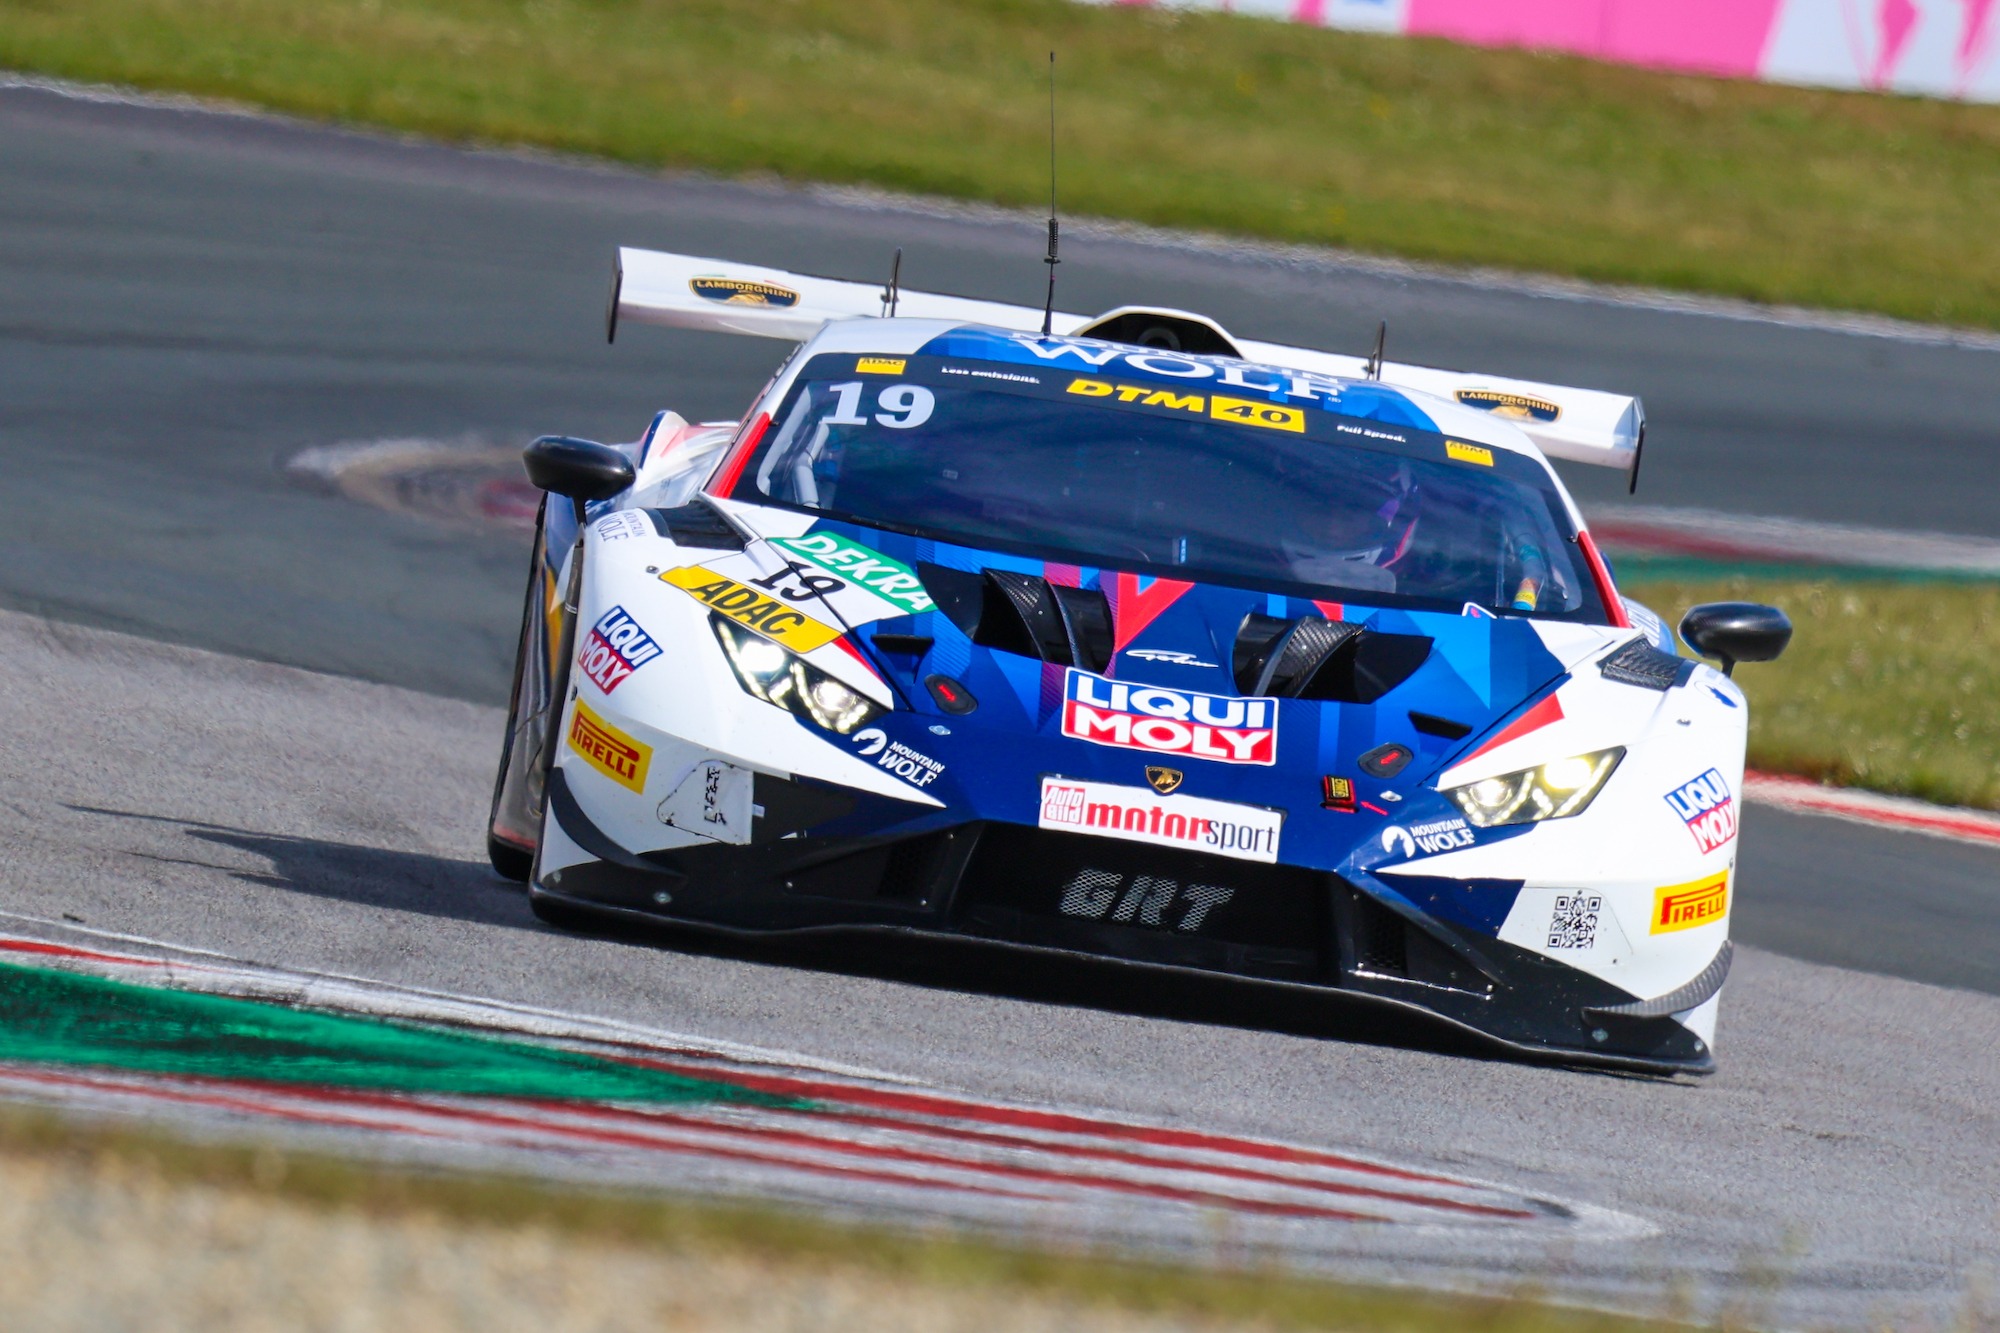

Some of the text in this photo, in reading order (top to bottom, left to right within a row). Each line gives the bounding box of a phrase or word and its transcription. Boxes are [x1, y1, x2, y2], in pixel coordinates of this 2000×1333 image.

[696, 281, 793, 299] LAMBORGHINI
[1010, 338, 1347, 400] WOLF
[821, 381, 935, 429] 19
[1066, 379, 1292, 424] DTM 40
[1461, 391, 1555, 413] LAMBORGHINI
[747, 560, 846, 601] 19
[783, 535, 933, 610] DEKRA
[686, 580, 806, 636] ADAC
[579, 633, 632, 689] MOLY
[596, 607, 660, 667] LIQUI
[1076, 675, 1265, 728] LIQUI
[572, 710, 640, 780] PIRELLI
[889, 741, 945, 773] MOUNTAIN
[1074, 705, 1271, 759] MOLY
[877, 750, 937, 787] WOLF
[1667, 769, 1728, 821] LIQUI
[1410, 818, 1466, 837] MOUNTAIN
[1414, 828, 1476, 854] WOLF
[1691, 802, 1735, 852] MOLY
[1059, 868, 1235, 931] GRT
[1660, 881, 1725, 925] PIRELLI
